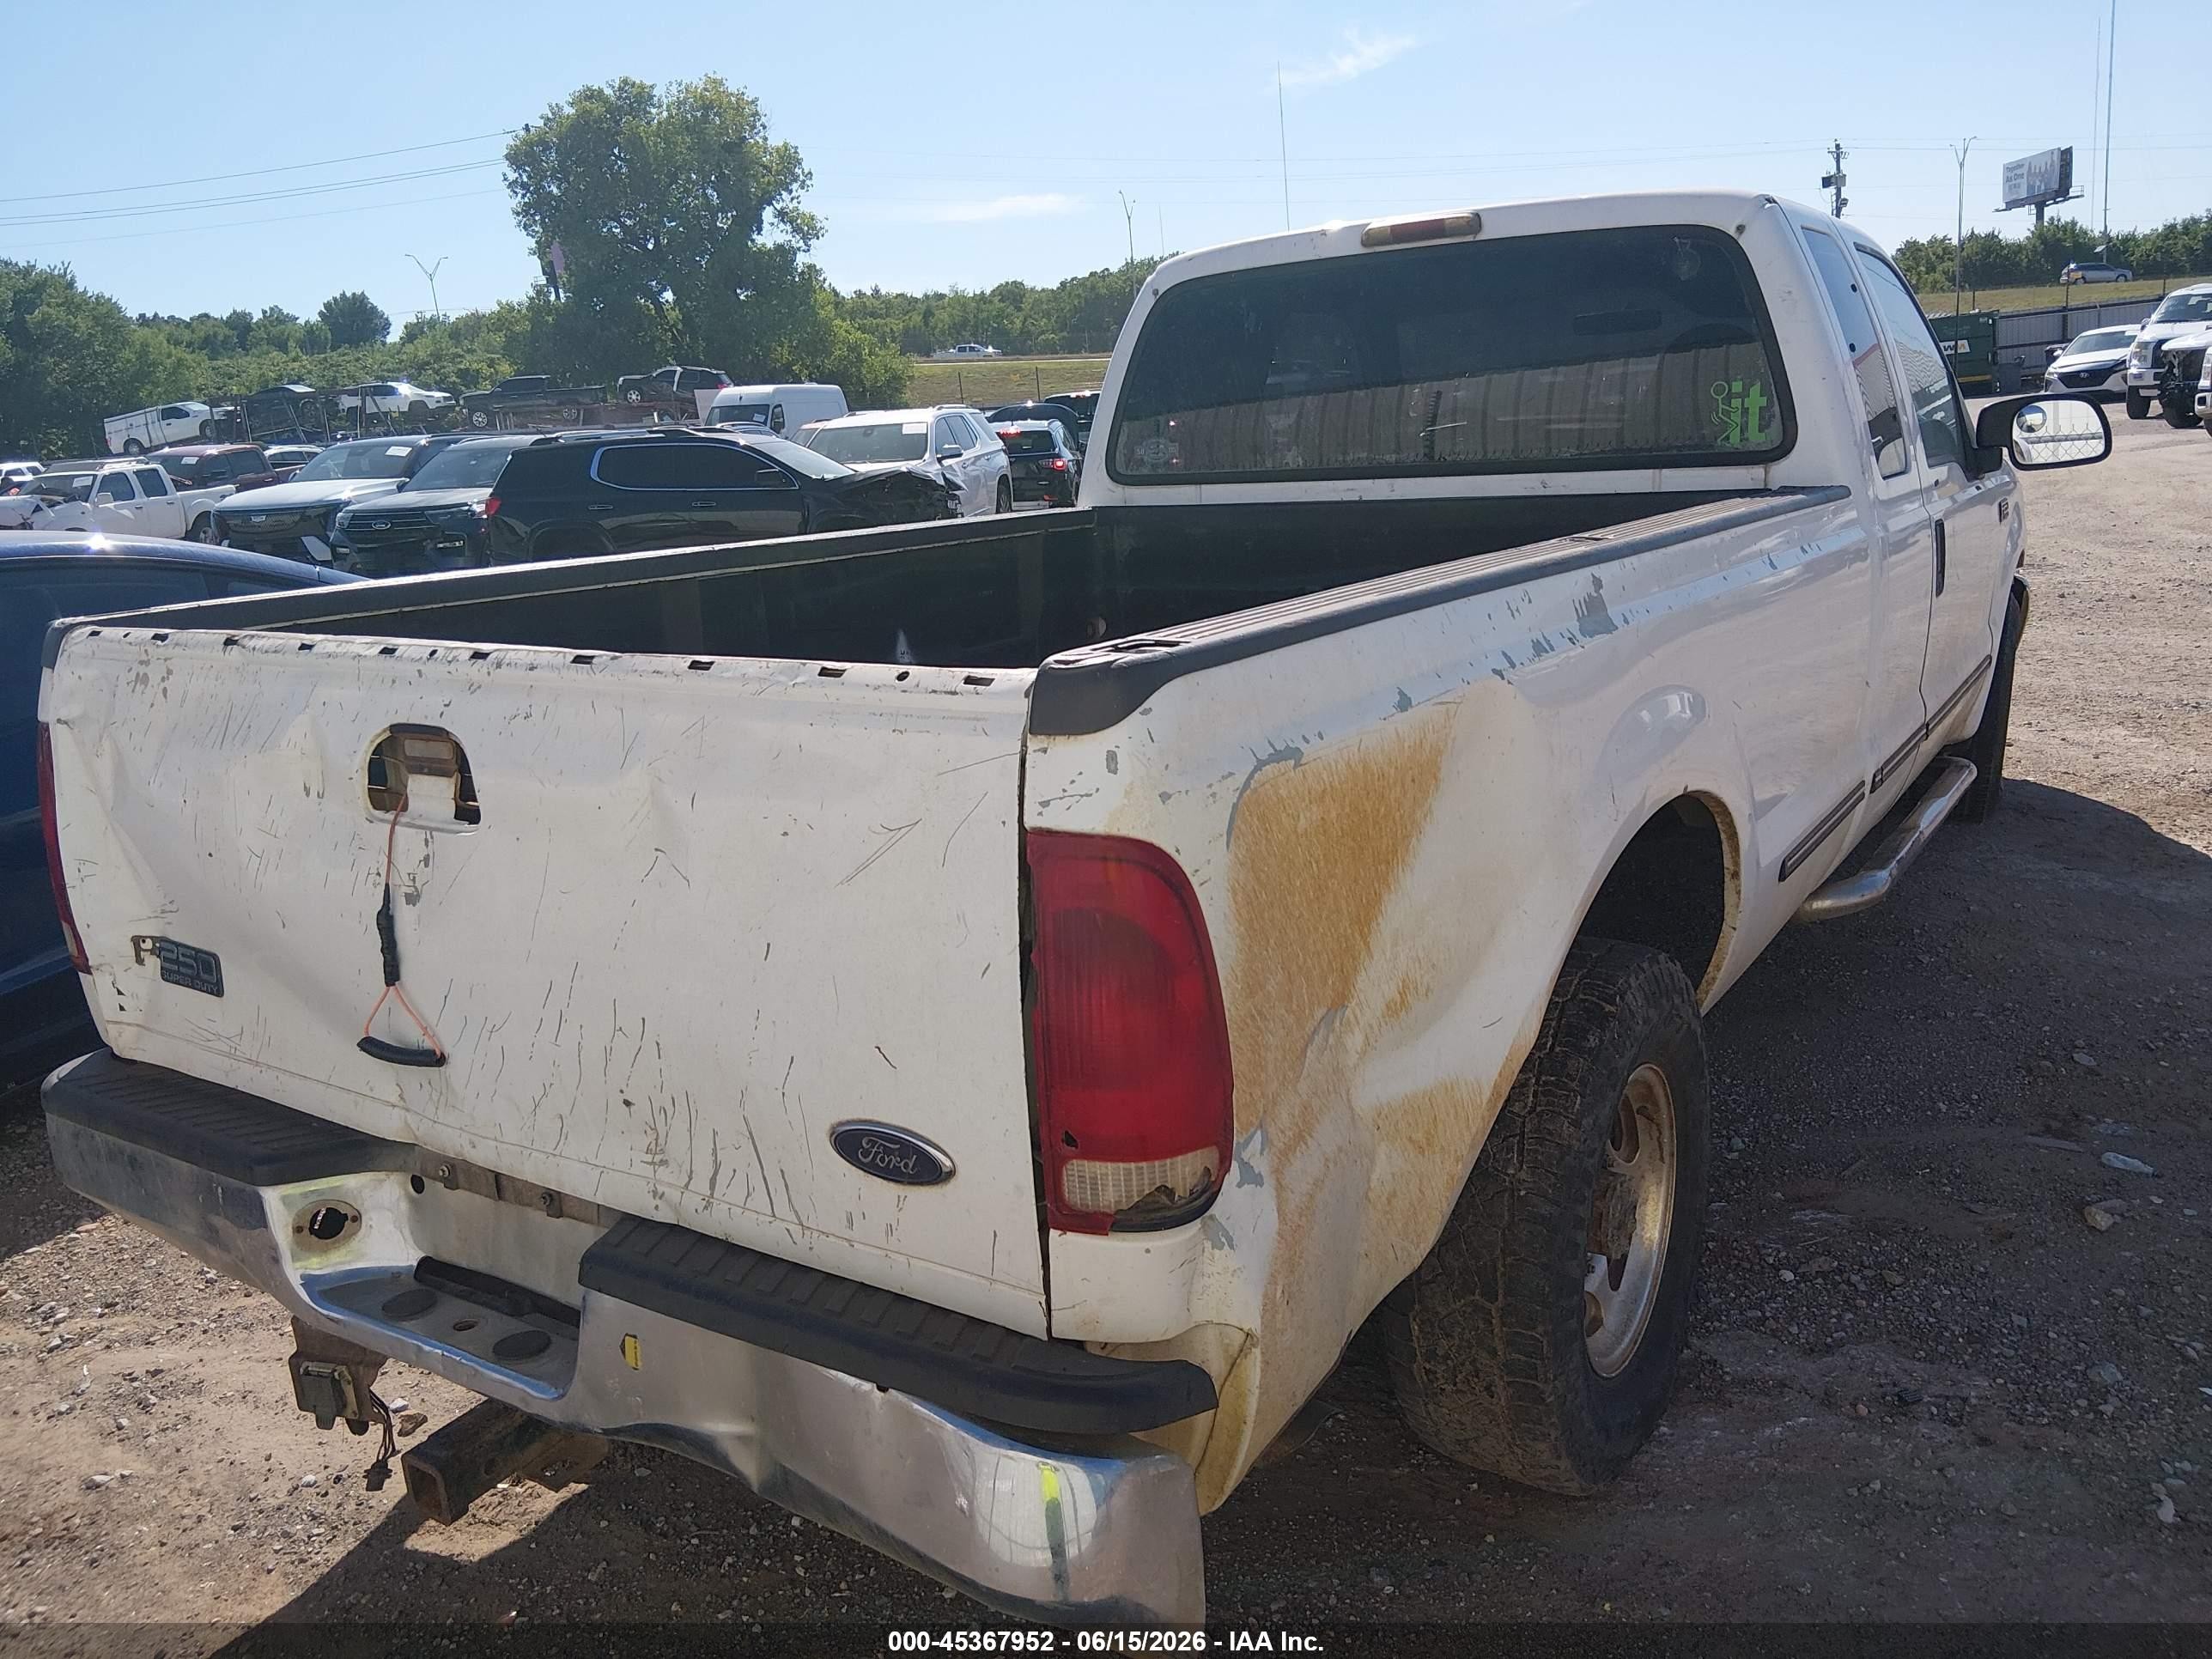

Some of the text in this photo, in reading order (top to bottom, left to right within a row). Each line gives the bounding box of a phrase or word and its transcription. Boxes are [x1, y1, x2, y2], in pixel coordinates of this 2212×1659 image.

[2014, 173, 2025, 181] One
[161, 969, 218, 994] SUPER DUTY
[859, 1136, 917, 1174] Ford
